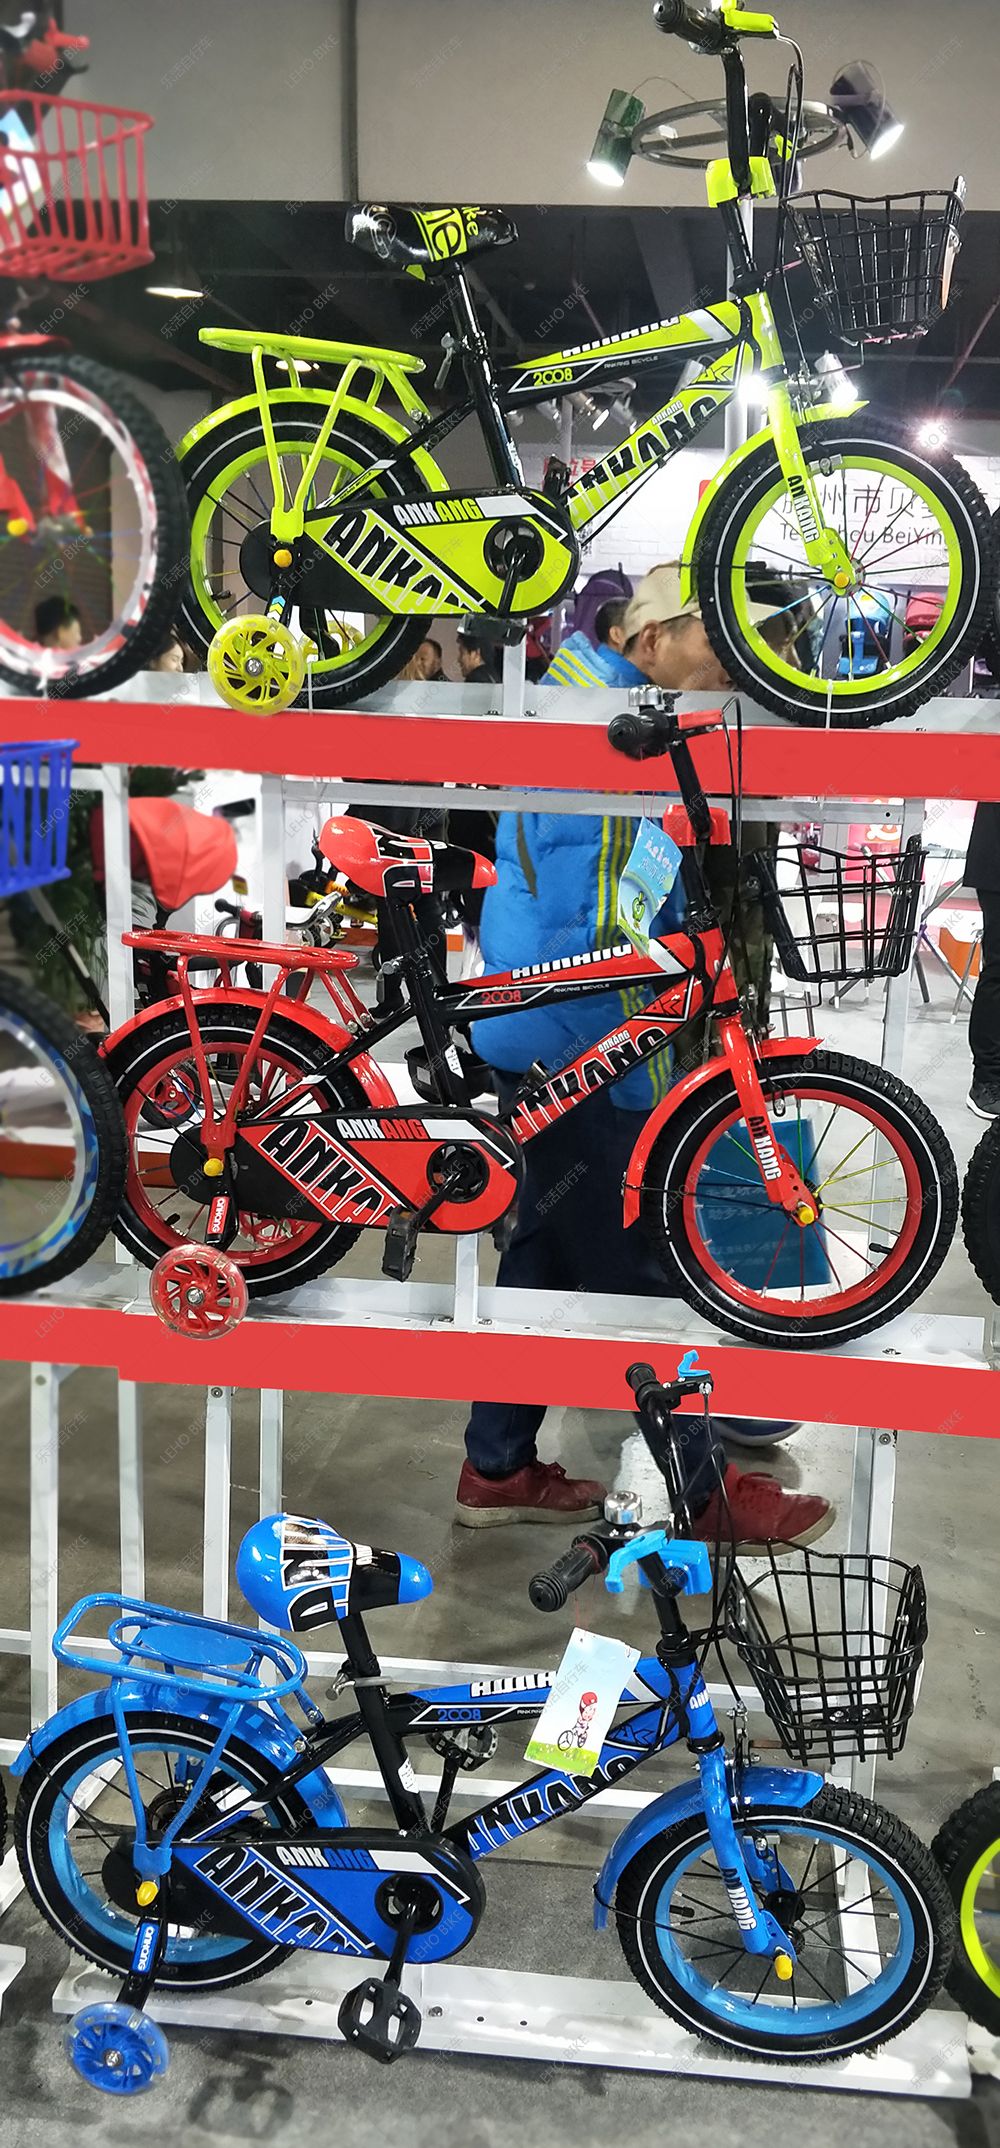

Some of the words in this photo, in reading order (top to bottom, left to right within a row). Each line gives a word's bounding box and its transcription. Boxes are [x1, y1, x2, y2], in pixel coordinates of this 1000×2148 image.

[532, 368, 574, 387] 2008
[652, 400, 684, 425] ANKANG
[393, 498, 484, 526] ANKANG
[787, 475, 820, 544] ANKANG
[481, 990, 522, 1005] 2008
[597, 1029, 631, 1053] ANKANG
[336, 1118, 428, 1140] ANKANG
[748, 1115, 782, 1181] ANKANG
[258, 1120, 400, 1225] ANKA
[437, 1708, 482, 1722] 2008
[276, 1846, 378, 1870] ANKANG
[720, 1867, 757, 1931] ANKANG
